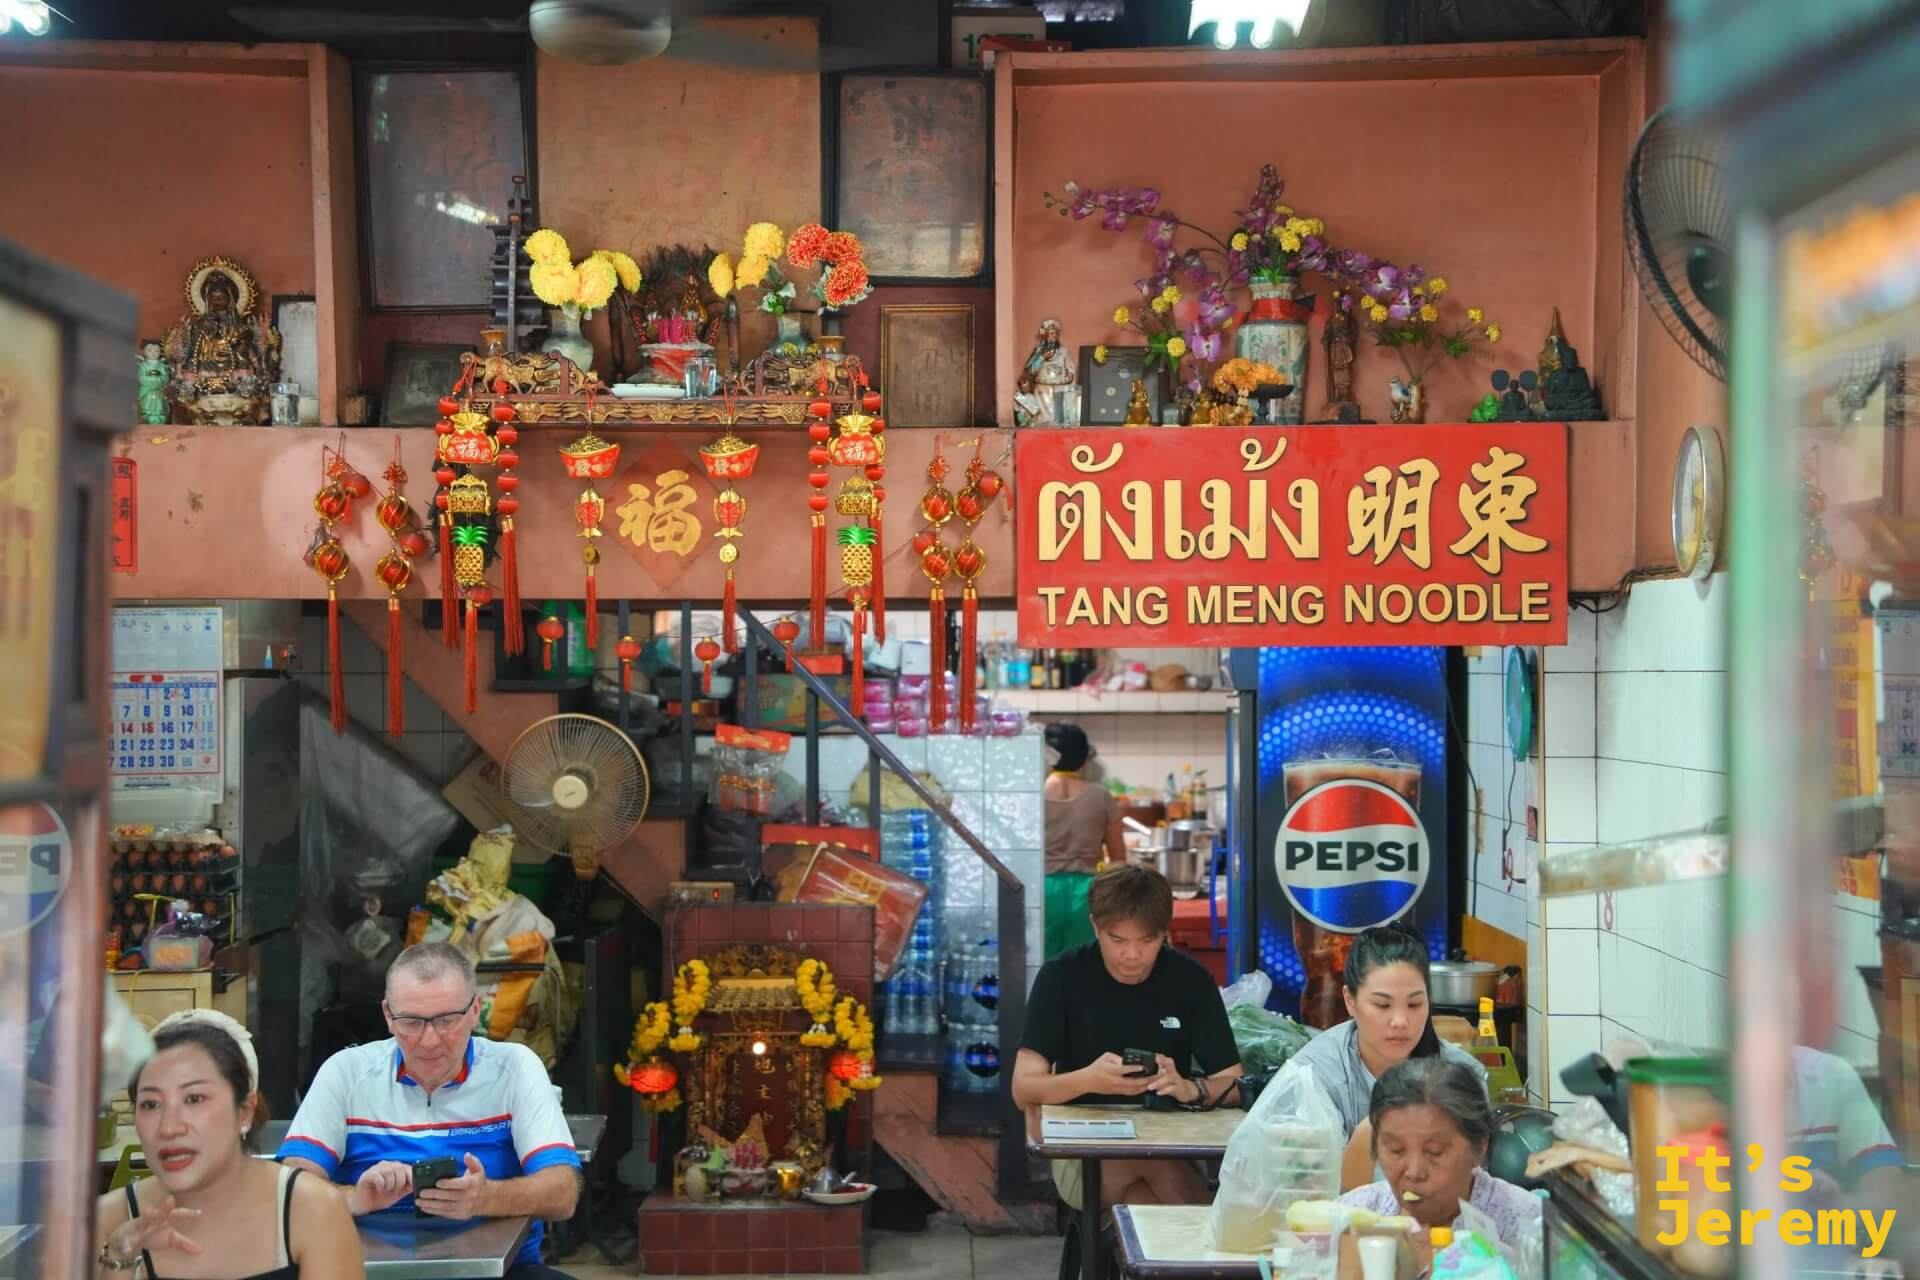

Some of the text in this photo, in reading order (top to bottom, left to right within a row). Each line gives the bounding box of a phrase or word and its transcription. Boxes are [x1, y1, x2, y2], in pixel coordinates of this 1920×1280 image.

[1038, 436, 1320, 561] ตังเม้ง
[615, 469, 702, 556] 福
[1037, 582, 1550, 625] TANG MENG NOODLE
[144, 688, 150, 700] 1
[163, 688, 171, 700] 2
[183, 688, 191, 700] 3
[123, 705, 131, 717] 7
[163, 705, 171, 717] 9
[181, 705, 194, 717] 10
[121, 722, 134, 734] 14
[141, 722, 155, 734] 15
[161, 722, 174, 734] 16
[181, 722, 194, 734] 17
[120, 738, 135, 751] 21
[139, 738, 155, 751] 22
[160, 738, 175, 751] 23
[179, 738, 195, 751] 24
[119, 755, 135, 768] 28
[139, 755, 155, 768] 29
[159, 755, 175, 768] 30
[1285, 841, 1419, 872] PEPSI
